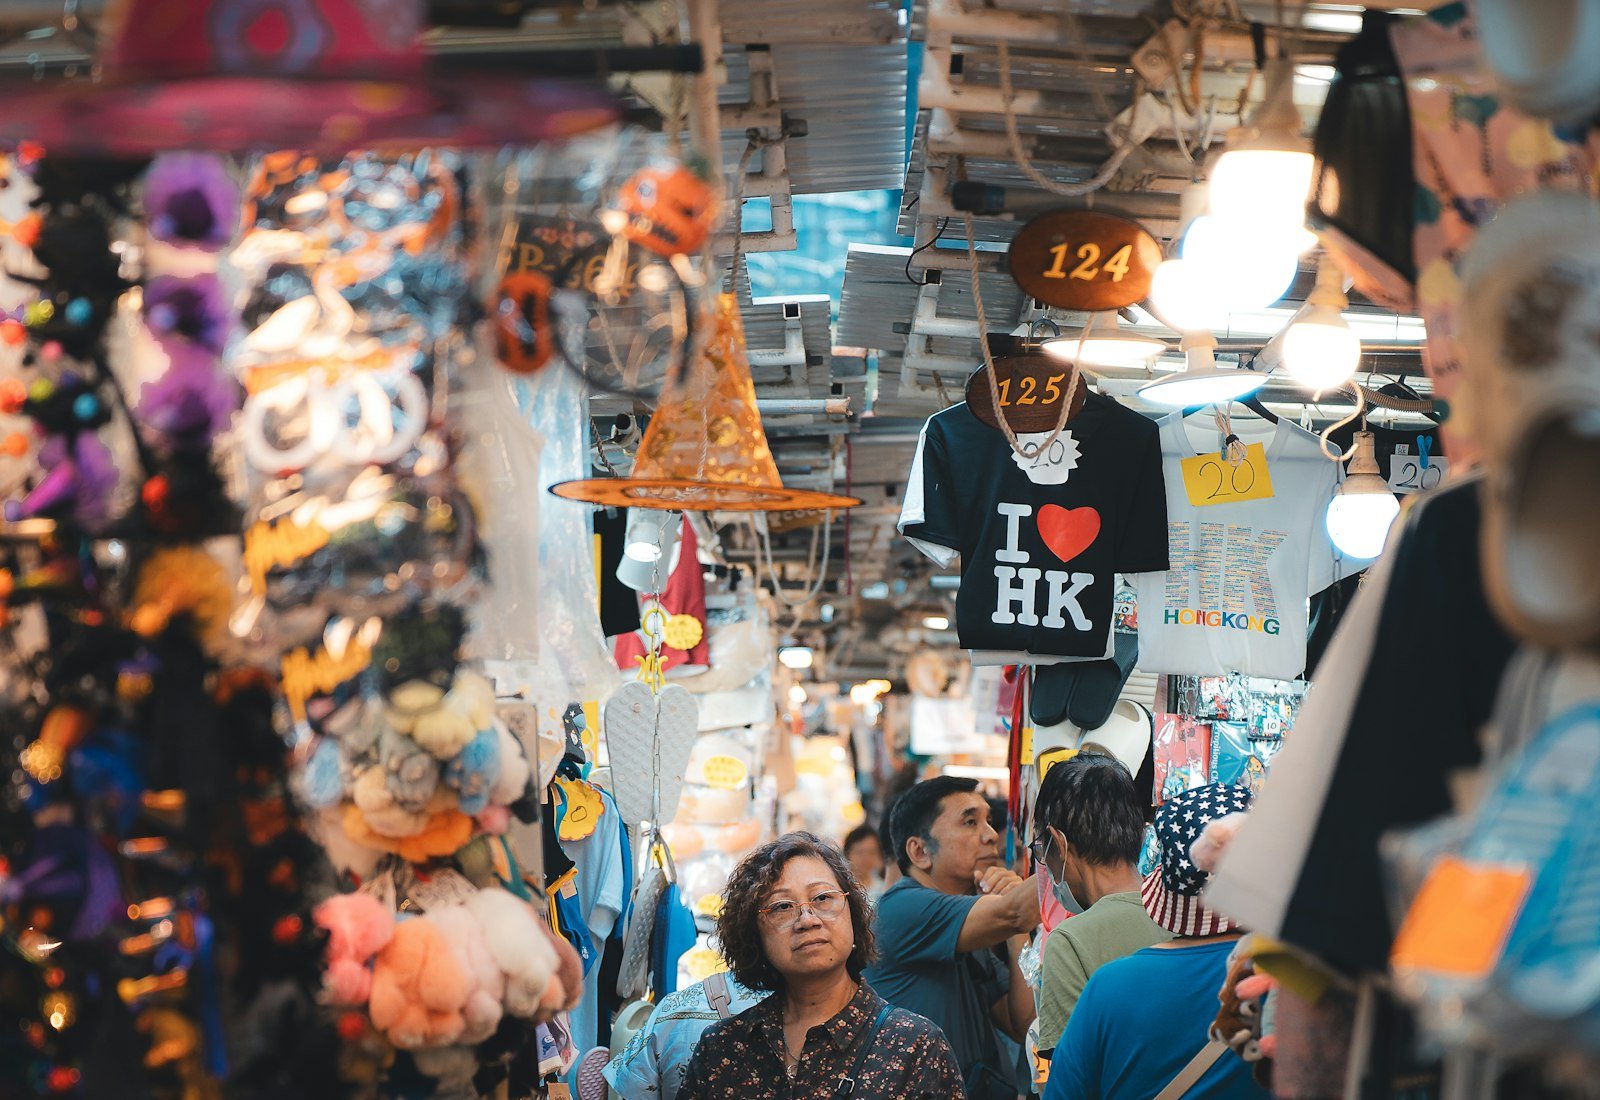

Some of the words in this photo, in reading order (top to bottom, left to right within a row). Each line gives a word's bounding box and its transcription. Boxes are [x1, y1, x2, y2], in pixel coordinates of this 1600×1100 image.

[1043, 243, 1133, 283] 124
[998, 373, 1066, 407] 125
[1023, 439, 1065, 469] 20
[1199, 458, 1255, 499] 20
[1395, 462, 1442, 490] 20
[995, 502, 1032, 564] I
[991, 565, 1095, 631] HK
[1163, 608, 1281, 635] HONGKONG
[1266, 722, 1277, 731] 10
